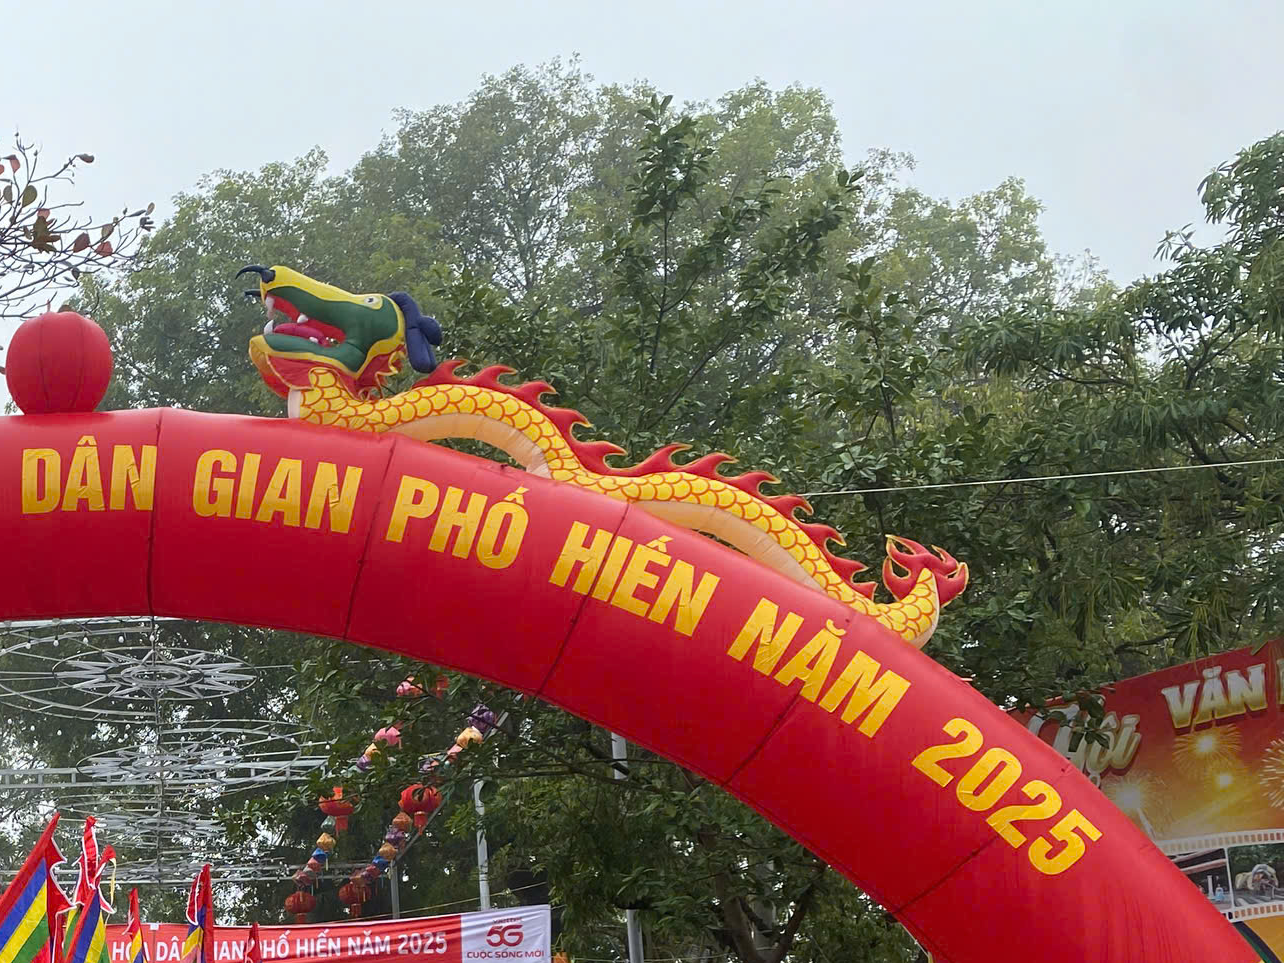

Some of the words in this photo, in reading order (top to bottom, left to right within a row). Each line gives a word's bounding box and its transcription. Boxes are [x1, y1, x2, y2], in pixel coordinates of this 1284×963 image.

[21, 435, 158, 514] DÂN
[192, 449, 363, 533] GIAN
[385, 484, 529, 569] PHỐ
[548, 520, 721, 637] HIẾN
[727, 597, 911, 738] NĂM
[911, 717, 1103, 876] 2025
[1162, 664, 1268, 730] VĂN
[213, 940, 245, 961] IAN
[259, 929, 291, 959] HỐ
[295, 929, 341, 958] HIẾN
[347, 929, 391, 955] NĂM
[398, 932, 448, 955] 2025
[486, 924, 524, 947] 5G
[467, 951, 493, 959] CUỘC
[495, 947, 523, 958] SỐNG
